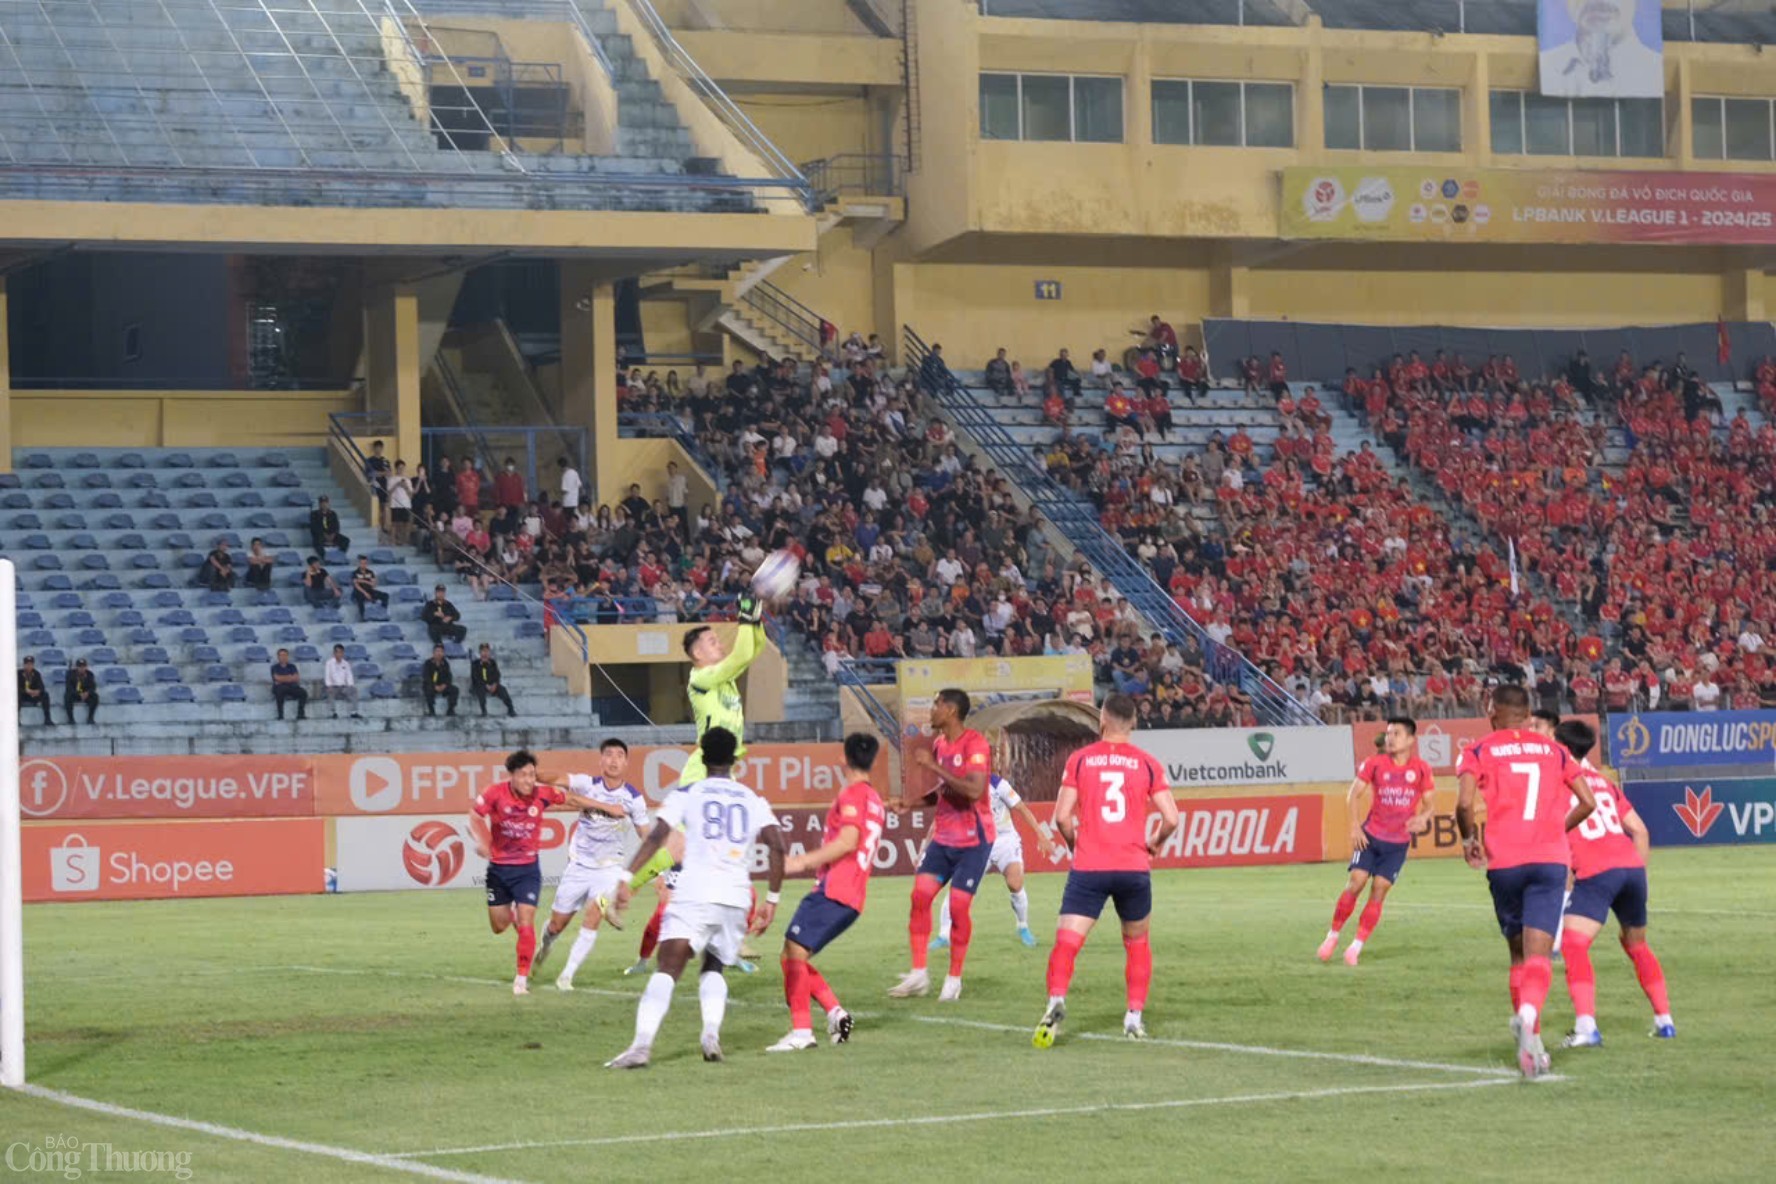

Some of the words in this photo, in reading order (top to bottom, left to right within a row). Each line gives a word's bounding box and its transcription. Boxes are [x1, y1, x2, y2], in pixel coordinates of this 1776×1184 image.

[1731, 191, 1754, 203] GIA
[1512, 207, 1587, 223] LPBANK
[1590, 208, 1676, 225] V.LEAGUE
[1678, 210, 1689, 226] 1
[1701, 210, 1772, 227] 2024/25
[1040, 282, 1057, 299] 11
[411, 764, 483, 800] FPT
[731, 756, 772, 791] PT
[1167, 759, 1287, 782] Vietcombank
[82, 771, 308, 809] V.League.VPF
[1099, 771, 1126, 823] 3
[1509, 762, 1541, 821] 7
[702, 800, 749, 844] 80
[1728, 801, 1776, 837] VP
[109, 851, 235, 891] Shopee
